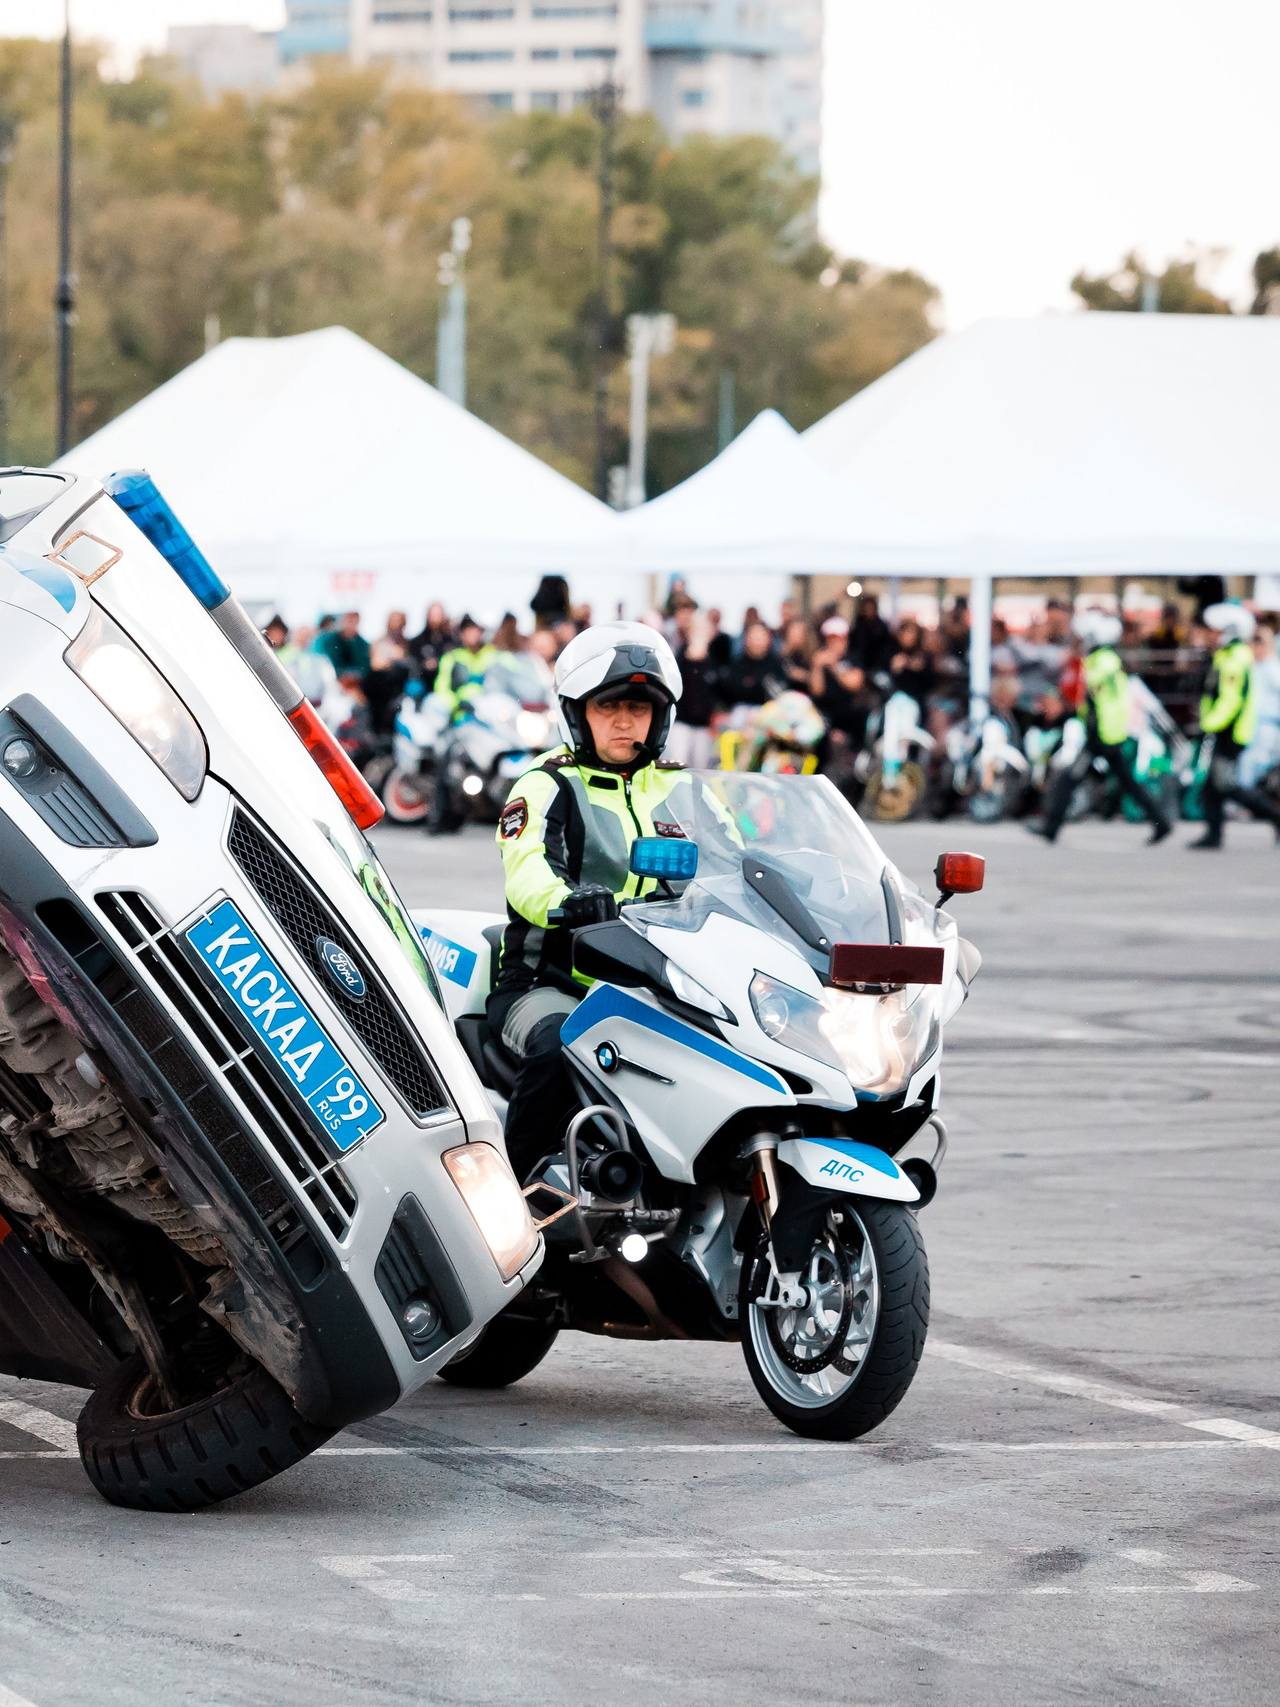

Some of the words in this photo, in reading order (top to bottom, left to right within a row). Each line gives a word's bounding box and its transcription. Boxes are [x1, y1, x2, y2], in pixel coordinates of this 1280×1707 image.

[329, 952, 359, 987] Ford
[205, 923, 325, 1083] КАСКАД
[326, 1076, 368, 1121] 99
[316, 1101, 342, 1131] RUS
[819, 1159, 864, 1182] ДПС
